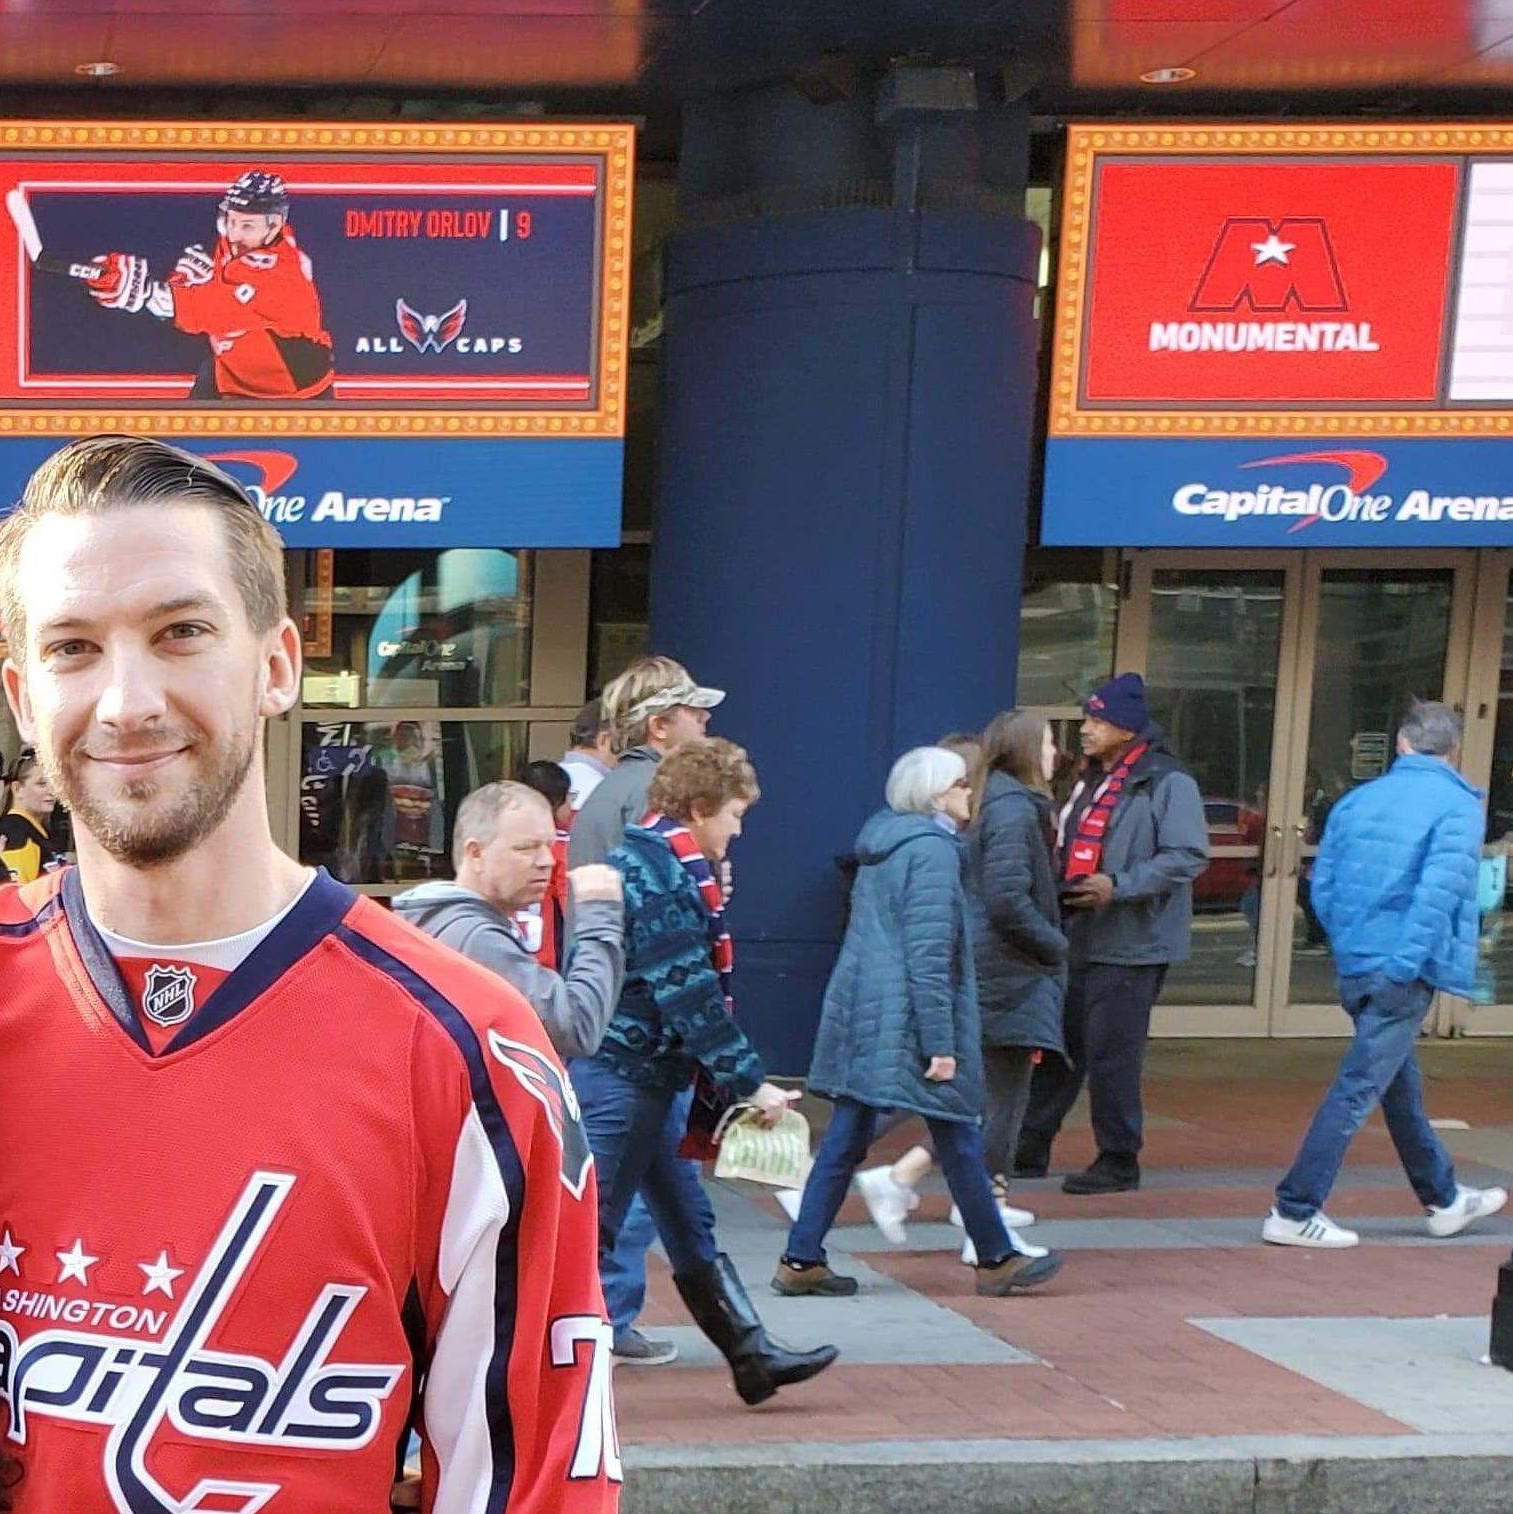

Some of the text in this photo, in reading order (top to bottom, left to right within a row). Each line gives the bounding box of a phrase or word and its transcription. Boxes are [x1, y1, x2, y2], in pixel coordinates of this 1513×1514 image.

[346, 209, 532, 239] DMITRY ORLOV 9
[69, 263, 102, 279] CCM
[356, 337, 523, 353] ALL CAPS
[1150, 322, 1380, 352] MONUMENTAL
[311, 491, 443, 522] Arena
[153, 983, 185, 1012] NHL
[550, 1312, 623, 1484] 7
